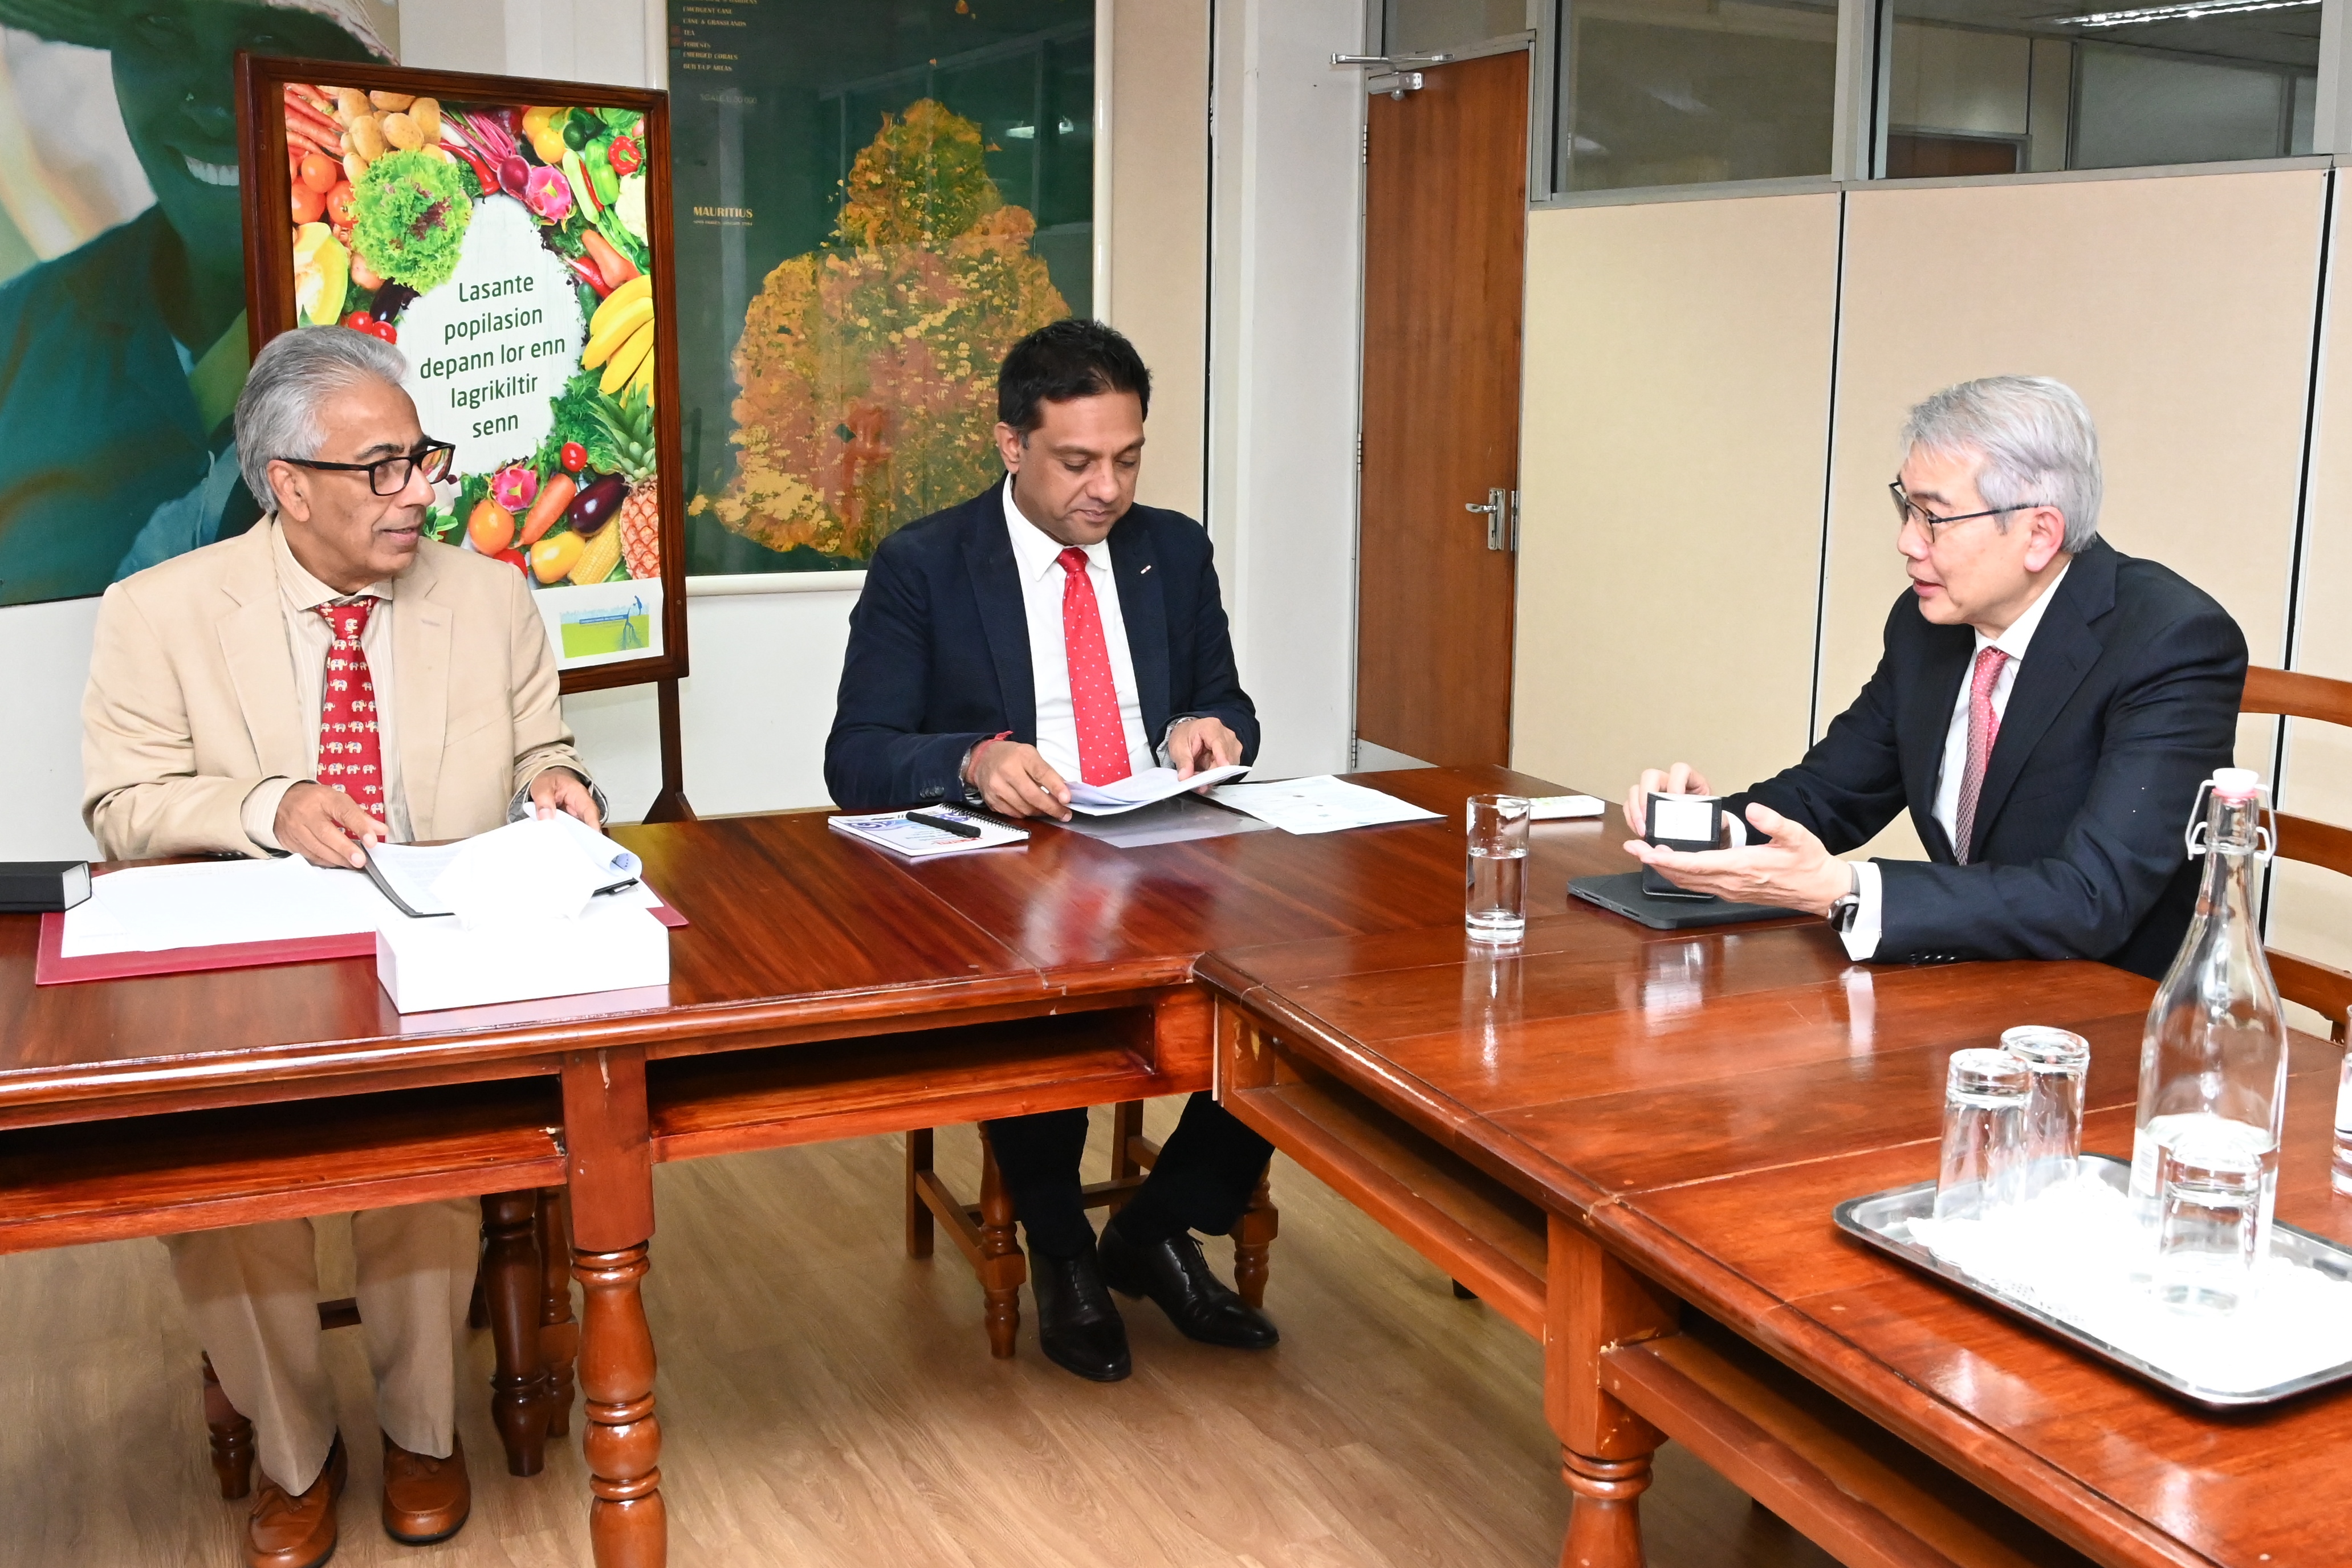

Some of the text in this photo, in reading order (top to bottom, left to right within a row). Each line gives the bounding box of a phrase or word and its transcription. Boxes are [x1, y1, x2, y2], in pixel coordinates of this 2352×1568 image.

[694, 206, 753, 218] MAURITIUS
[459, 275, 534, 303] Lasante
[445, 307, 543, 345] popilasion
[420, 338, 565, 380] depann lor enn
[451, 373, 538, 409] lagrikiltir
[473, 414, 518, 438] senn
